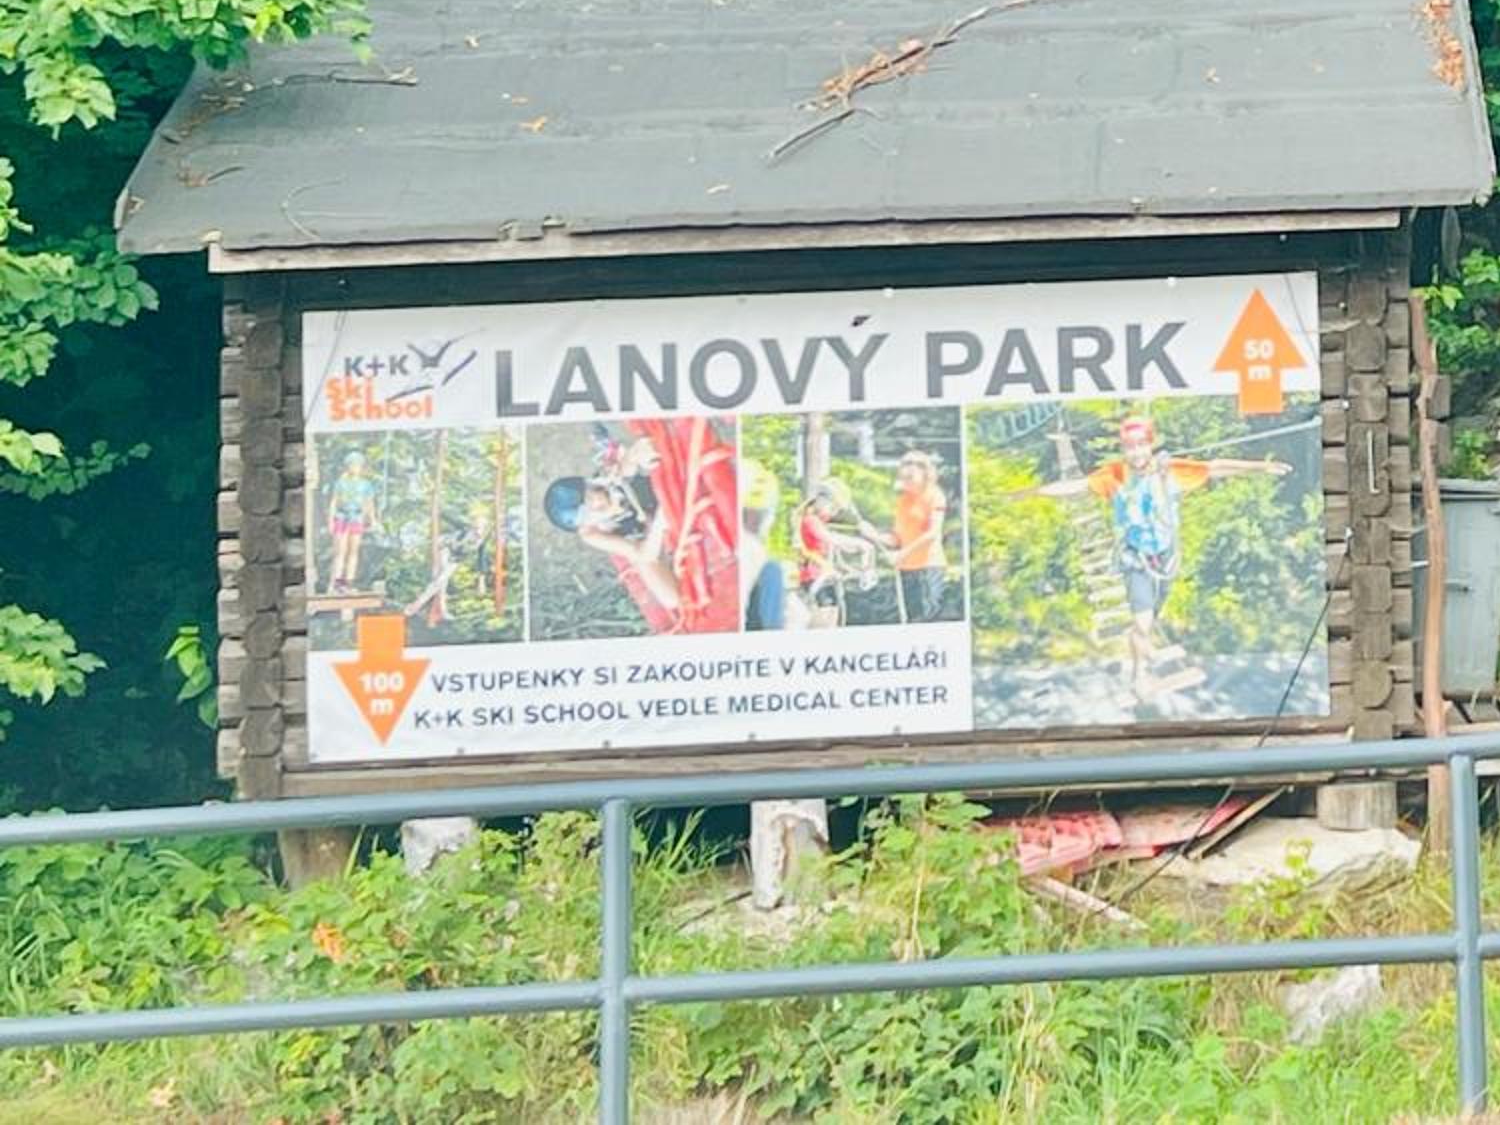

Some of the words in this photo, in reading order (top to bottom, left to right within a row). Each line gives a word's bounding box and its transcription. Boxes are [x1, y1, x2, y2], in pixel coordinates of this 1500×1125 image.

[1244, 339, 1274, 360] 50
[344, 355, 408, 377] K+K
[495, 315, 891, 418] LANOVÝ
[925, 321, 1188, 399] PARK
[1247, 365, 1272, 380] m
[326, 374, 374, 402] Ski
[329, 395, 433, 421] School
[358, 672, 404, 692] 100
[431, 667, 583, 693] VSTUPENKY
[594, 665, 617, 685] SI
[627, 655, 769, 683] ZAKOUPÍTE
[779, 658, 796, 675] V
[370, 698, 393, 715] m
[413, 709, 463, 729] K+K
[473, 706, 513, 725] SKI
[524, 701, 629, 725] SCHOOL
[638, 695, 719, 718] VEDLE
[728, 690, 842, 714] MEDICAL
[849, 684, 948, 707] CENTER
